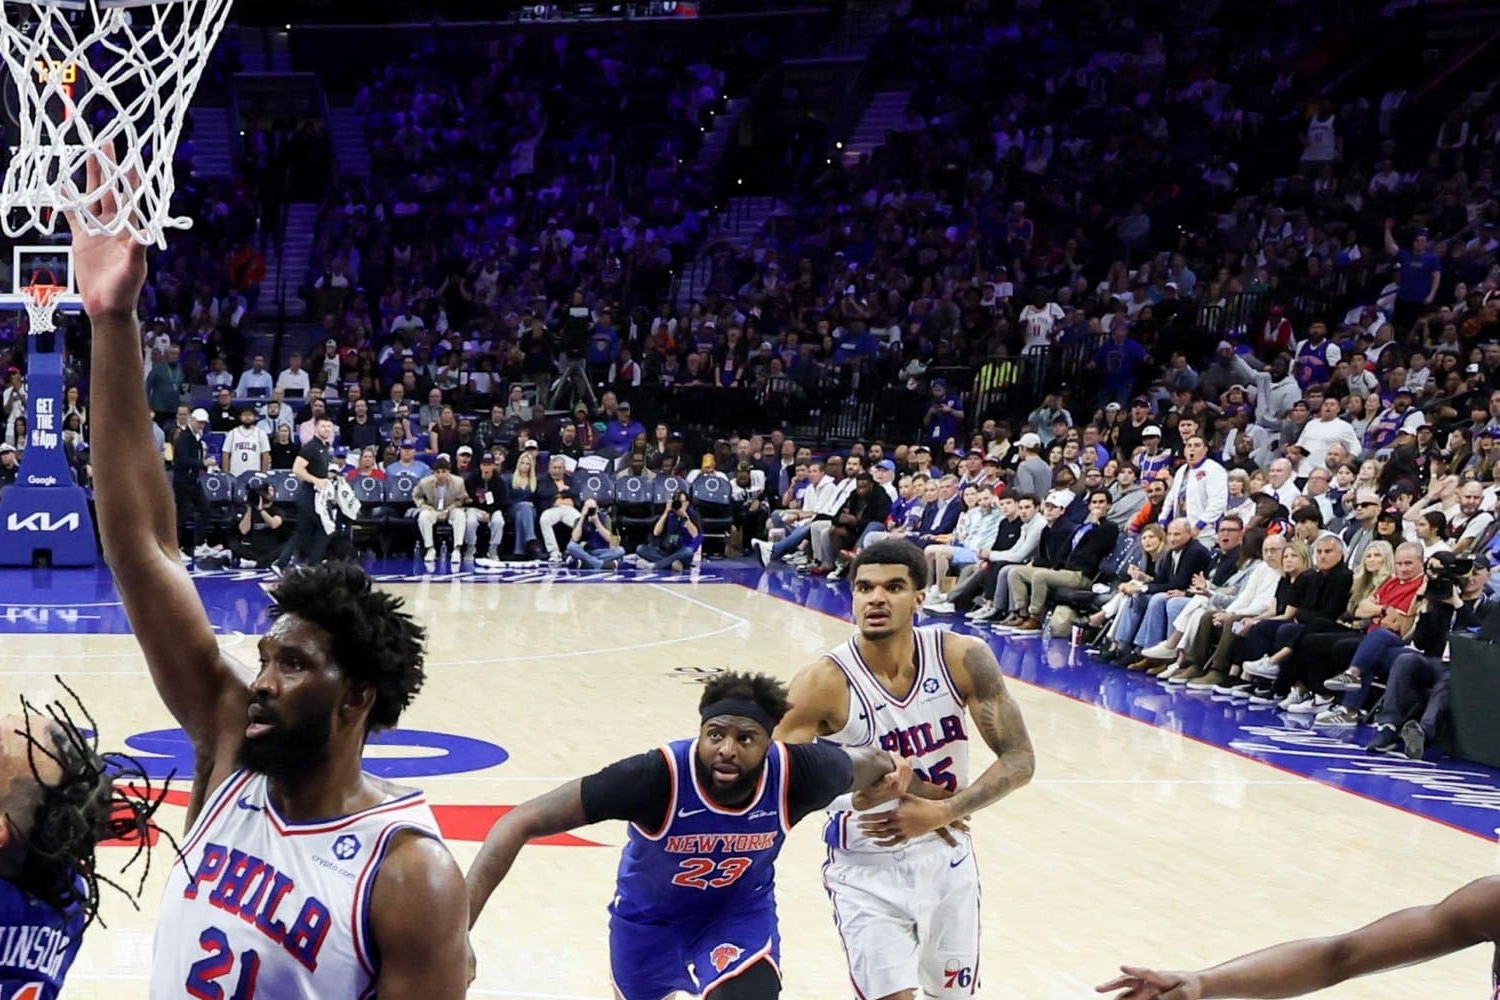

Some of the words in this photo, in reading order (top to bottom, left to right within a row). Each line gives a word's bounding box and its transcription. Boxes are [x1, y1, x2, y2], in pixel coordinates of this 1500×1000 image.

[36, 398, 54, 414] GET
[36, 415, 54, 430] THE
[27, 475, 56, 486] Google
[7, 512, 79, 531] KIA
[664, 833, 716, 854] NEW
[713, 829, 779, 853] YORK
[311, 853, 356, 880] crypto.com
[671, 856, 753, 890] 23
[183, 842, 332, 973] PHILA
[943, 966, 972, 989] 76
